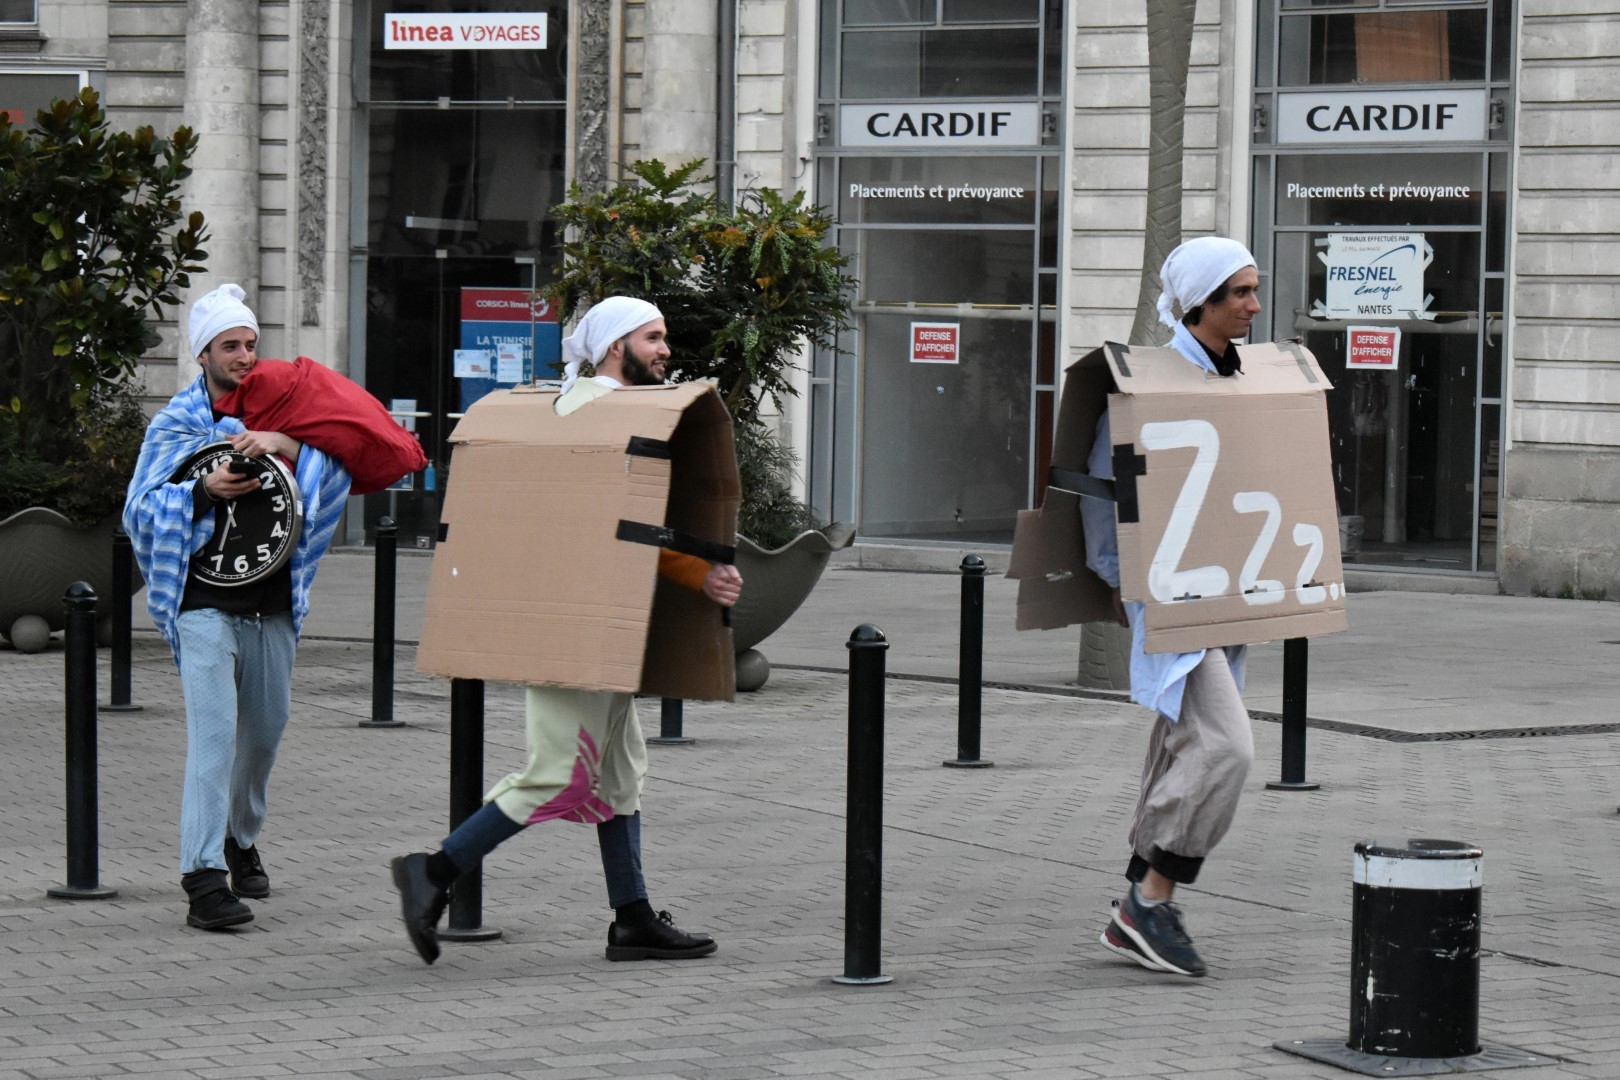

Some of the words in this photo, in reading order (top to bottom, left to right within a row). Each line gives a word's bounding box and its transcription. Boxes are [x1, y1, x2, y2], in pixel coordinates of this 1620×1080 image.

[391, 20, 453, 42] linea
[460, 25, 541, 42] VOYAGES
[867, 112, 1011, 137] CARDIF
[1306, 103, 1458, 132] CARDIF
[849, 184, 925, 198] Placements
[929, 185, 943, 198] et
[947, 183, 1024, 202] prévoyance
[1287, 183, 1365, 198] Placements
[1370, 183, 1384, 198] et
[1389, 181, 1470, 202] prévoyance
[1342, 235, 1366, 243] TRAVAUX
[1329, 266, 1397, 281] FRESNEL
[1354, 281, 1404, 300] énergie
[476, 300, 509, 308] CORSICA
[510, 300, 529, 308] linea
[1357, 305, 1393, 315] NANTES
[476, 336, 490, 345] LA
[492, 336, 533, 346] TUNISIE
[915, 343, 955, 353] D'AFFICHER
[1352, 347, 1392, 357] D'AFFICHER
[260, 471, 275, 490] 2
[272, 494, 286, 512] 3
[270, 520, 285, 538] 4
[256, 543, 271, 561] 5
[210, 554, 224, 572] 7
[234, 555, 249, 573] 6
